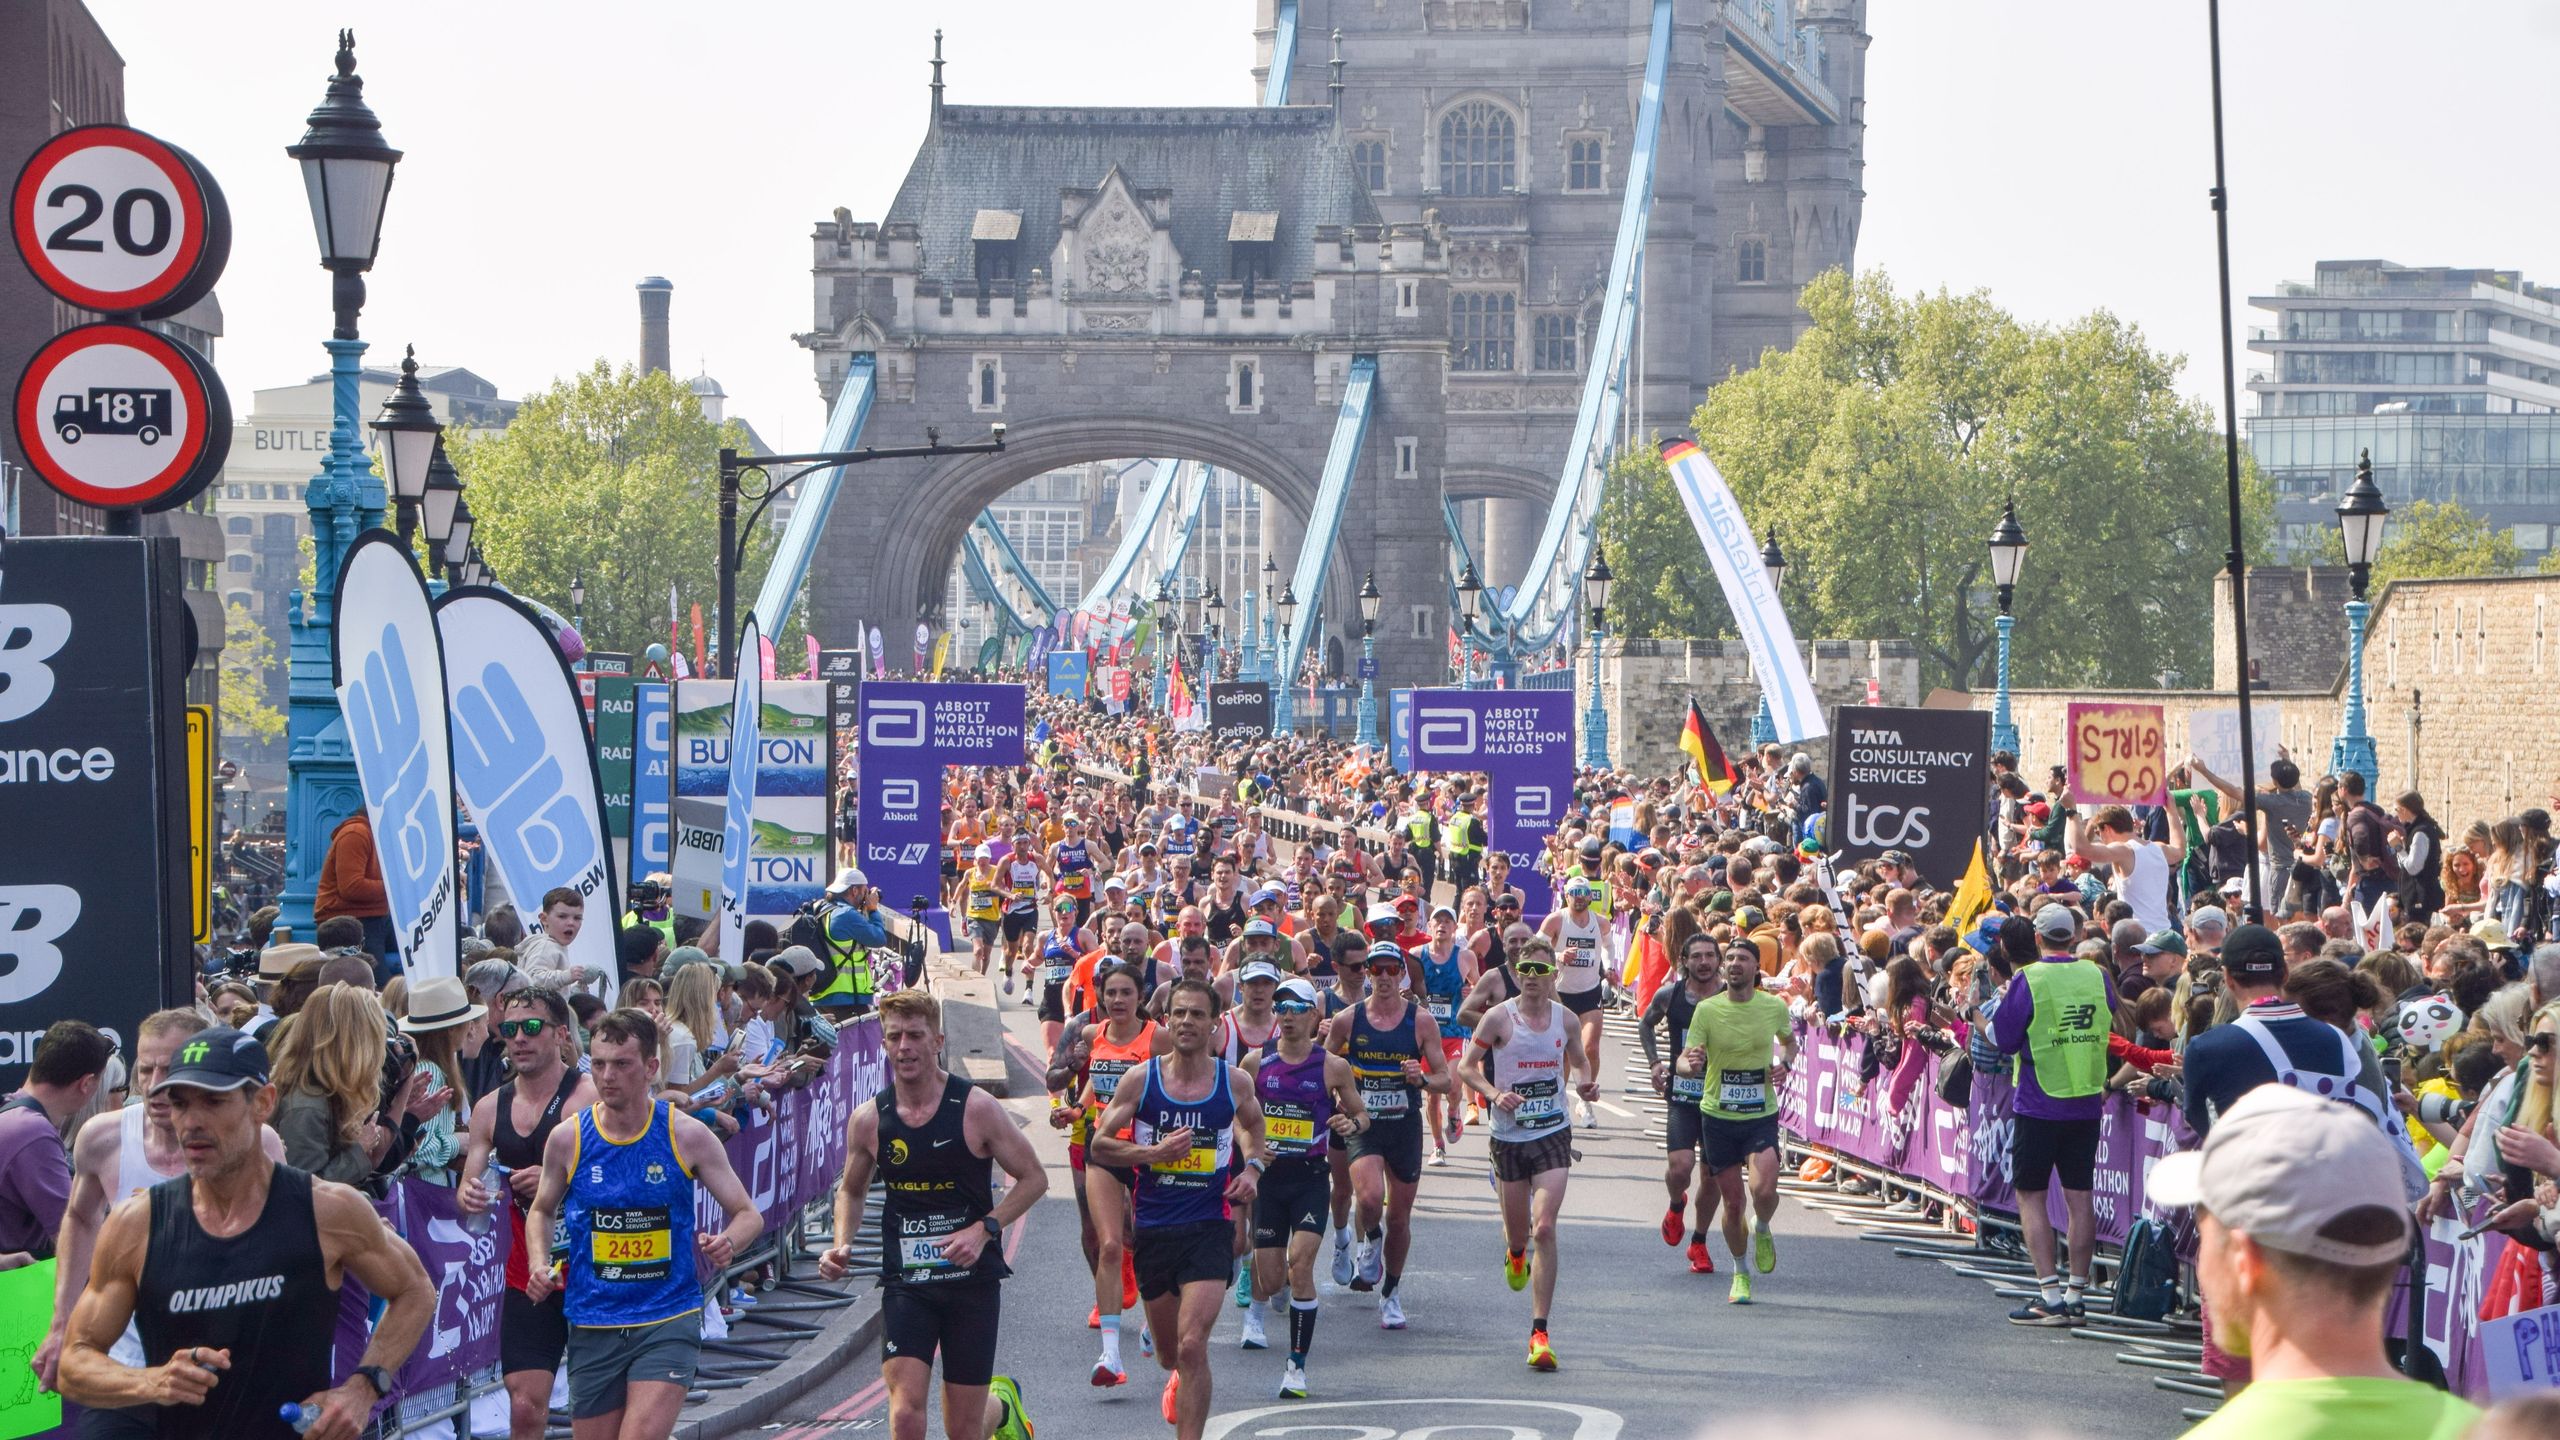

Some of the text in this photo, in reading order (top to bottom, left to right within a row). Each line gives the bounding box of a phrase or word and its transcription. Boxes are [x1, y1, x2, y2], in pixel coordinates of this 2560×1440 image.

[46, 184, 172, 256] 20
[256, 430, 334, 451] BUTLE
[597, 661, 623, 672] TAG
[1217, 693, 1262, 705] GetPRO
[934, 701, 991, 713] ABBOTT
[934, 713, 985, 724] WORLD
[1484, 708, 1540, 719] ABBOTT
[934, 725, 1018, 737] MARATHON
[1218, 726, 1264, 737] GetPRO
[1484, 720, 1534, 731] WORLD
[934, 737, 993, 748] MAJORS
[1484, 732, 1567, 742] MARATHON
[1851, 729, 1902, 745] TATA
[690, 739, 814, 764] BUTON
[1484, 743, 1543, 754] MAJORS
[1850, 748, 1973, 767] CONSULTANCY
[1849, 767, 1927, 784] SERVICES
[2107, 766, 2157, 801] GO
[882, 811, 918, 822] Abbott
[1847, 792, 1930, 848] tcs
[1516, 818, 1550, 828] Abbott
[869, 842, 897, 861] tcs
[0, 1027, 122, 1065] ane
[2051, 1036, 2069, 1048] new
[1518, 1060, 1560, 1069] INTERVAL
[1364, 1077, 1379, 1089] tcs
[1723, 1072, 1740, 1083] tcs
[1680, 1079, 1704, 1092] 4983
[1728, 1088, 1758, 1099] 49733
[1368, 1094, 1401, 1107] 47517
[1264, 1102, 1284, 1116] tcs
[1160, 1110, 1205, 1129] PAUL
[1272, 1122, 1301, 1137] 4914
[934, 1181, 955, 1190] AC
[2093, 1167, 2129, 1195] RATHON
[595, 1210, 623, 1230] tcs
[625, 1215, 666, 1224] CONSULTANCY
[903, 1217, 927, 1234] tcs
[928, 1216, 966, 1227] CONSULTANCY
[625, 1222, 652, 1230] SERVICES
[929, 1225, 954, 1233] SERVICES
[608, 1238, 654, 1259] 2432
[913, 1243, 941, 1260] 490
[637, 1270, 665, 1279] balance
[944, 1270, 970, 1279] balance
[169, 1274, 286, 1313] OLYMPIKUS
